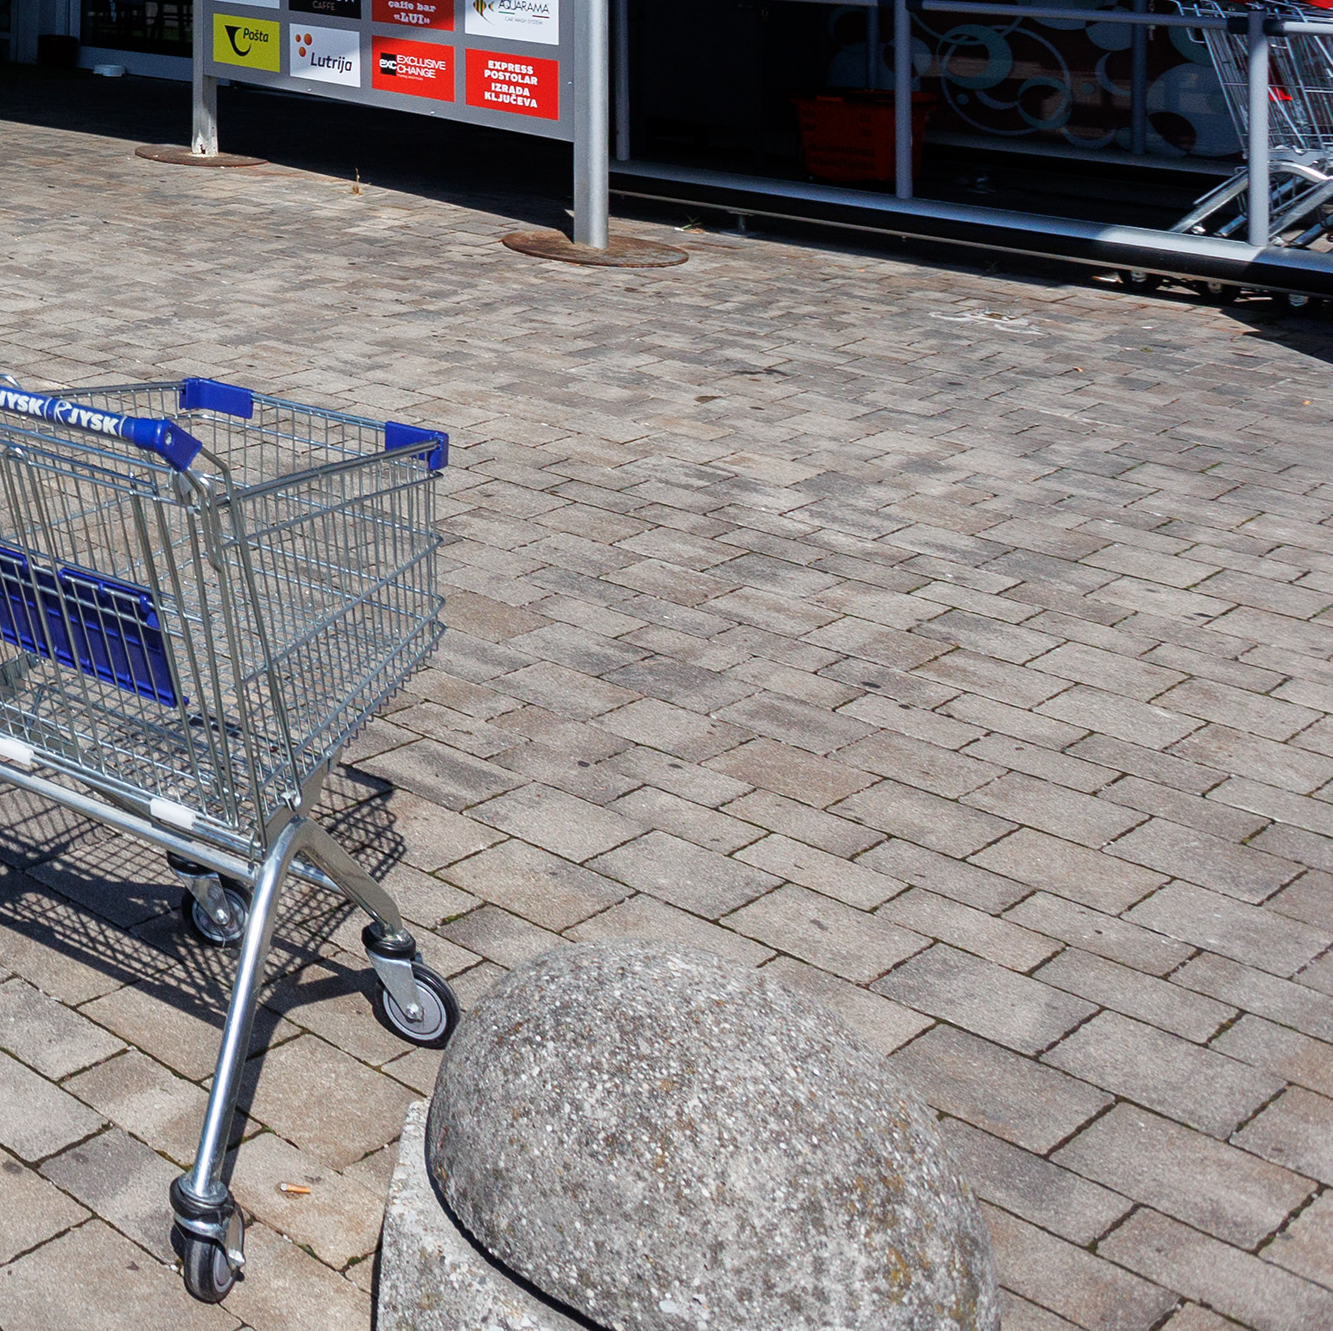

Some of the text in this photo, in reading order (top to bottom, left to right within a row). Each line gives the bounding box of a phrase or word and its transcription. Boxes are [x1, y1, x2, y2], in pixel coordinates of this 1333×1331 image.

[387, 0, 437, 13] caffe bar
[243, 27, 269, 43] Pošta
[310, 52, 353, 74] Lutrija
[379, 58, 397, 70] exc
[397, 54, 446, 71] EXCLUSIVE
[487, 60, 534, 75] EXPRESS
[397, 63, 437, 79] CHANGE
[484, 69, 538, 86] POSTOLAR
[491, 82, 531, 97] IZRADA
[484, 91, 538, 108] KLJUČEVA
[67, 407, 120, 436] JYSK
